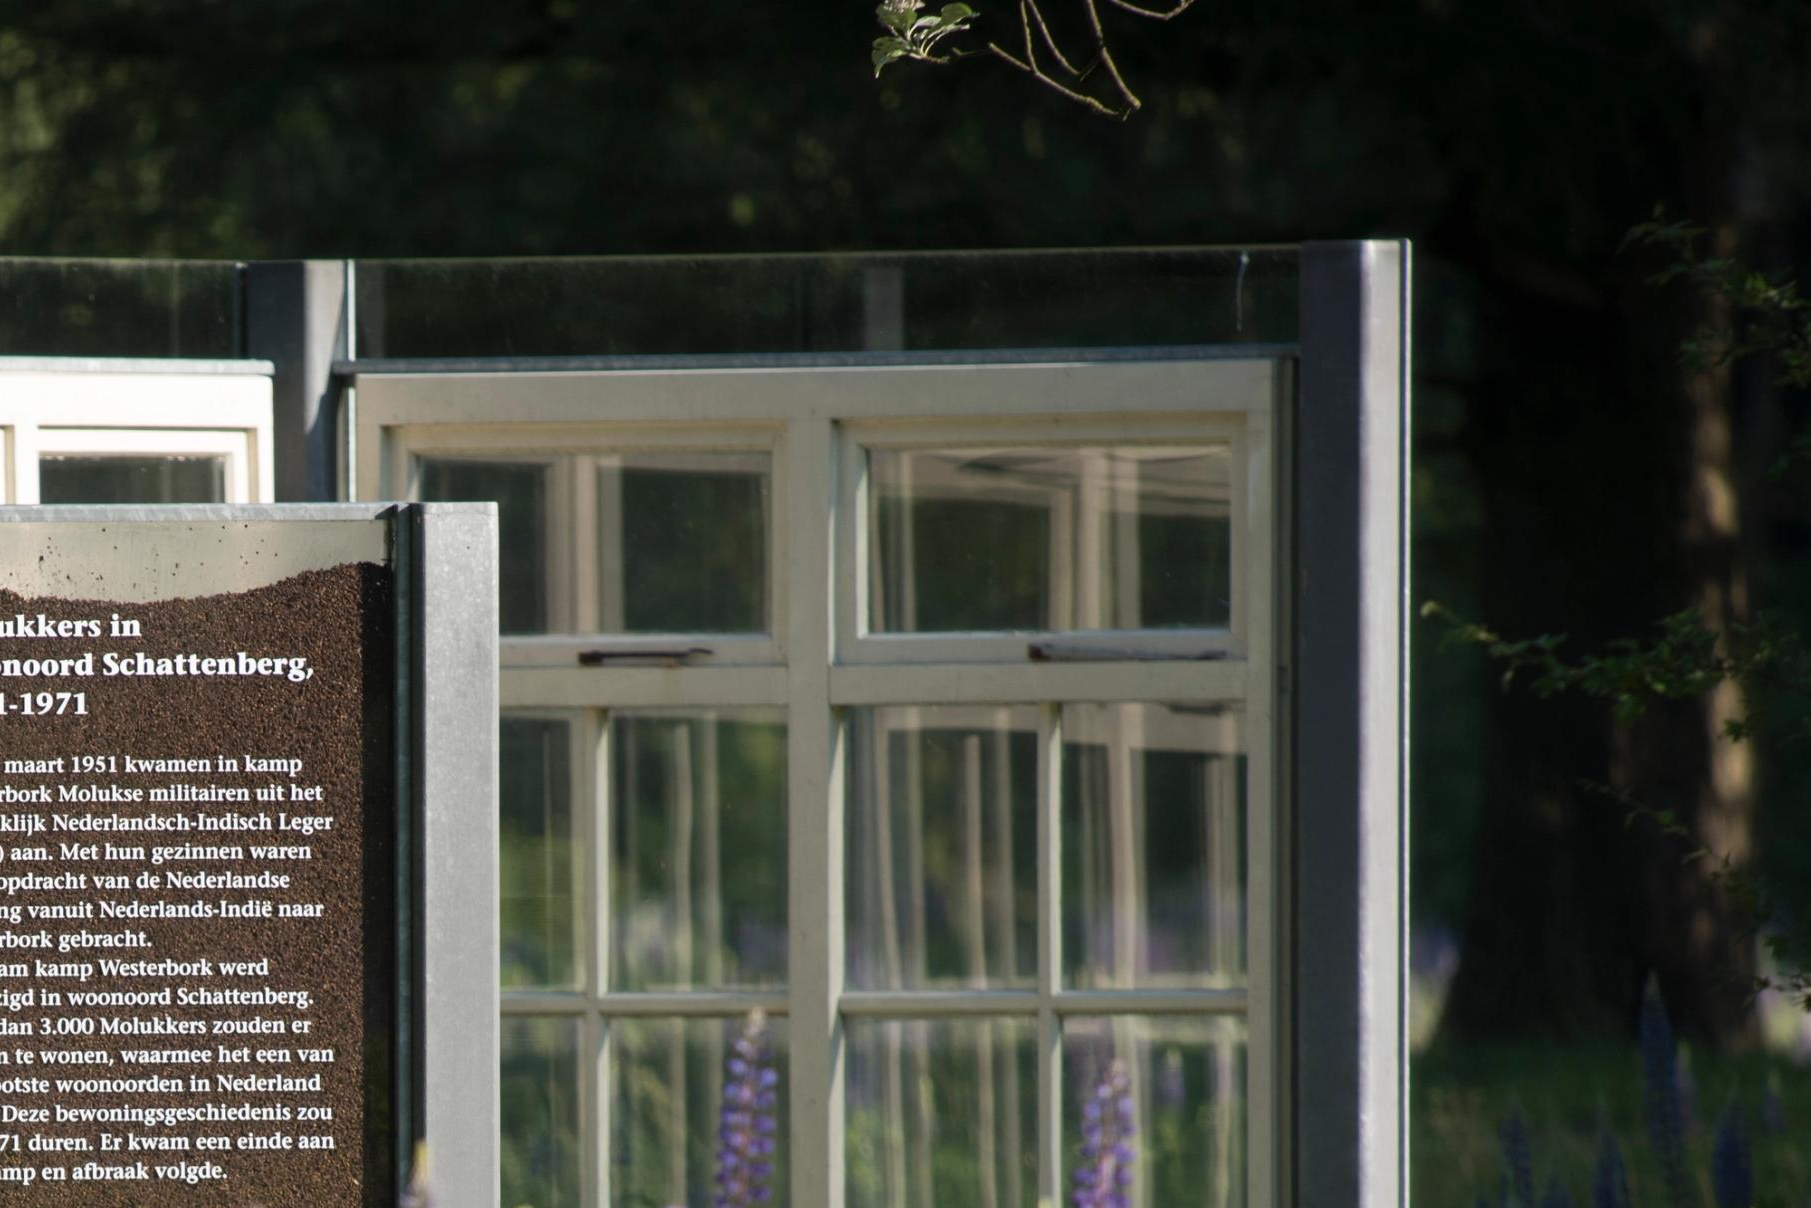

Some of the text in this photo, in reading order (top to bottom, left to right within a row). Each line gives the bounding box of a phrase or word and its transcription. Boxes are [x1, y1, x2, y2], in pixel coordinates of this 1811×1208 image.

[109, 613, 142, 637] in
[102, 651, 314, 681] Schattenberg,
[3, 757, 65, 774] maart
[71, 755, 118, 773] 1951
[124, 755, 212, 773] kwamen
[217, 754, 239, 773] in
[243, 754, 303, 778] kamp
[57, 784, 144, 803] Molukse
[149, 783, 251, 802] militairen
[255, 783, 285, 802] uit
[290, 783, 324, 802] het
[51, 812, 273, 832] Nederlandsch-Indisch
[278, 812, 334, 836] Leger
[10, 847, 54, 861] aan.
[59, 842, 99, 861] Met
[104, 842, 146, 861] hun
[151, 842, 244, 865] gezinnen
[249, 845, 312, 860] waren
[92, 875, 131, 890] van
[135, 871, 161, 890] de
[165, 870, 291, 889] Nederlandse
[27, 900, 94, 919] vanuit
[98, 899, 273, 919] Nederlands-Indië
[277, 903, 325, 918] naar
[58, 929, 153, 953] gebracht.
[34, 959, 94, 982] kamp
[97, 958, 214, 977] Westerbork
[218, 957, 269, 976] werd
[40, 988, 62, 1007] in
[66, 987, 172, 1006] woonoord
[176, 986, 314, 1010] Schattenberg.
[39, 1017, 95, 1036] 3.000
[99, 1015, 207, 1035] Molukkers
[212, 1015, 286, 1034] zouden
[291, 1020, 312, 1034] er
[14, 1048, 35, 1065] te
[39, 1050, 114, 1067] wonen,
[119, 1049, 213, 1064] waarmee
[217, 1045, 251, 1063] het
[255, 1049, 292, 1064] een
[296, 1048, 335, 1063] van
[55, 1074, 184, 1093] woonoorden
[189, 1074, 211, 1092] in
[216, 1073, 322, 1092] Nederland
[1, 1104, 50, 1123] Deze
[54, 1102, 292, 1127] bewoningsgeschiedenis
[296, 1106, 333, 1121] zou
[28, 1133, 94, 1152] duren.
[100, 1132, 123, 1151] Er
[127, 1132, 191, 1151] kwam
[195, 1136, 232, 1151] een
[236, 1131, 293, 1150] einde
[298, 1135, 335, 1150] aan
[41, 1166, 67, 1181] en
[71, 1161, 150, 1181] afbraak
[154, 1160, 228, 1185] volgde.
